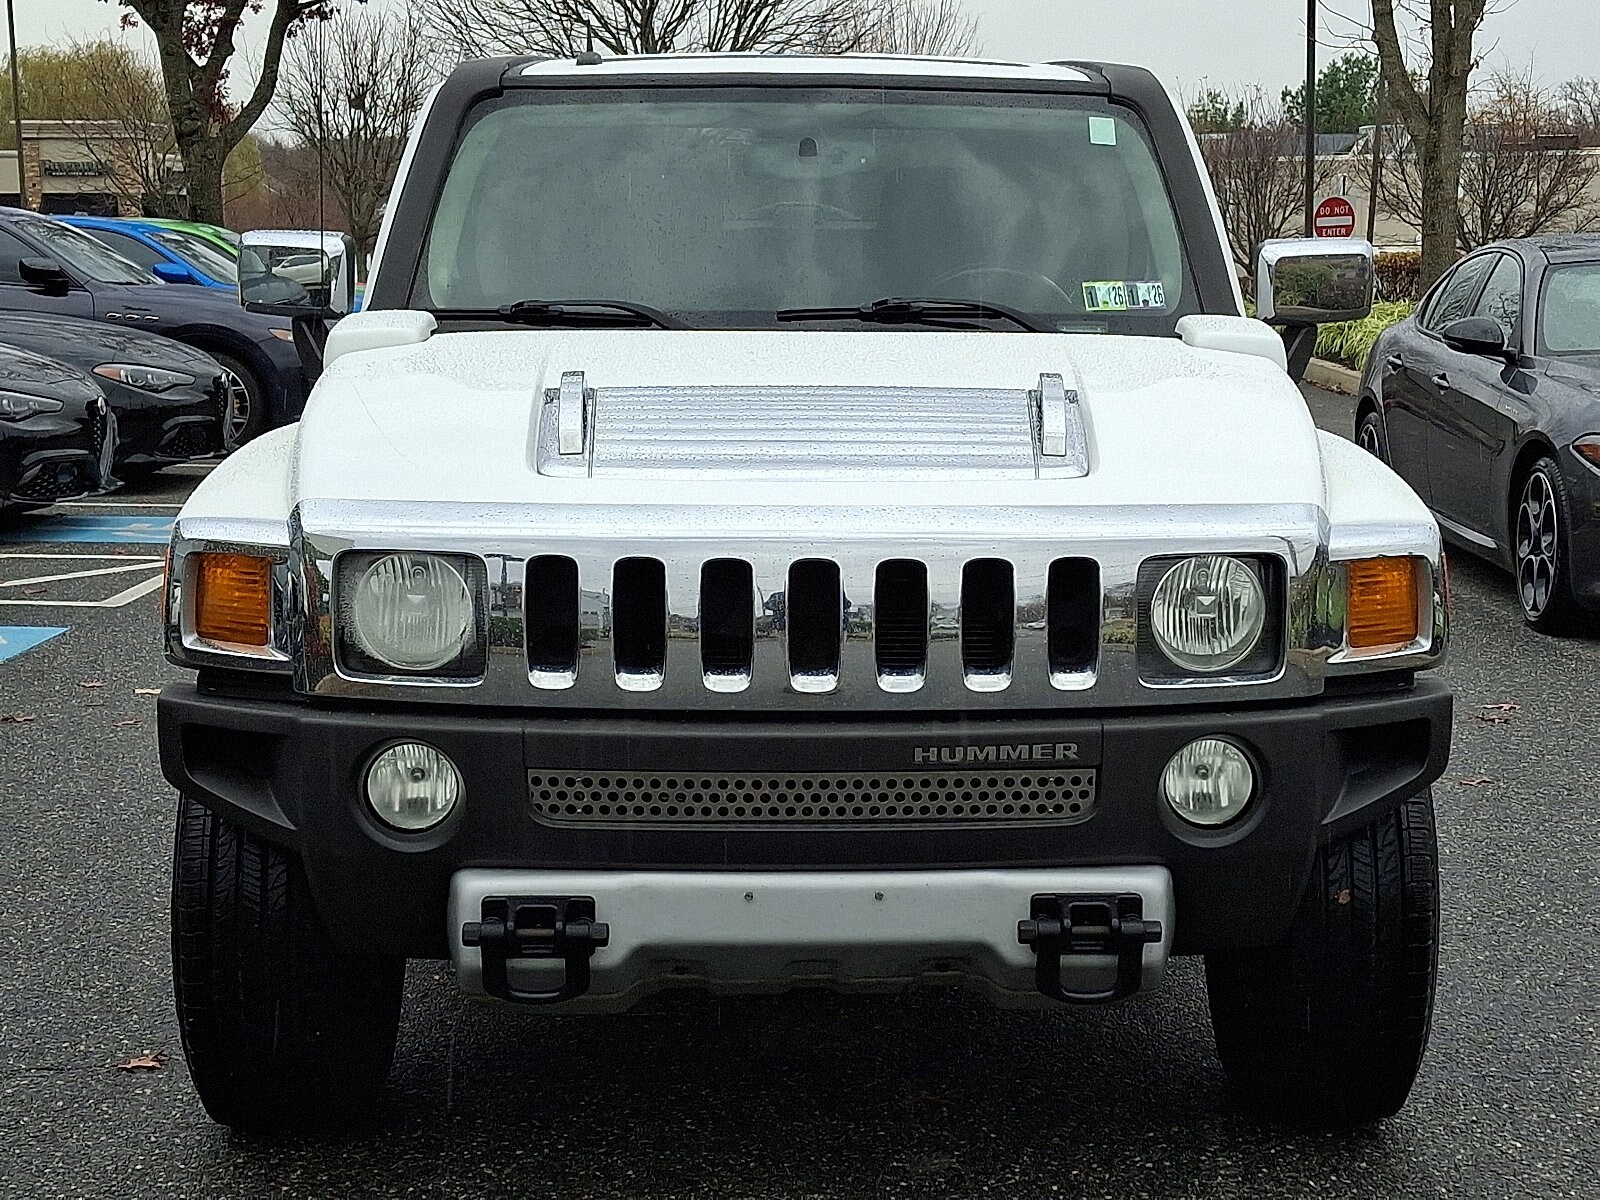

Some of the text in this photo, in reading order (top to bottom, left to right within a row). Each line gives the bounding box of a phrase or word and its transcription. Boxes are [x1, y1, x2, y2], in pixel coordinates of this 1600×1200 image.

[1320, 205, 1350, 215] DO NOT
[1322, 228, 1346, 237] ENTER
[1151, 284, 1164, 304] 26
[913, 742, 1080, 763] HUMMER
